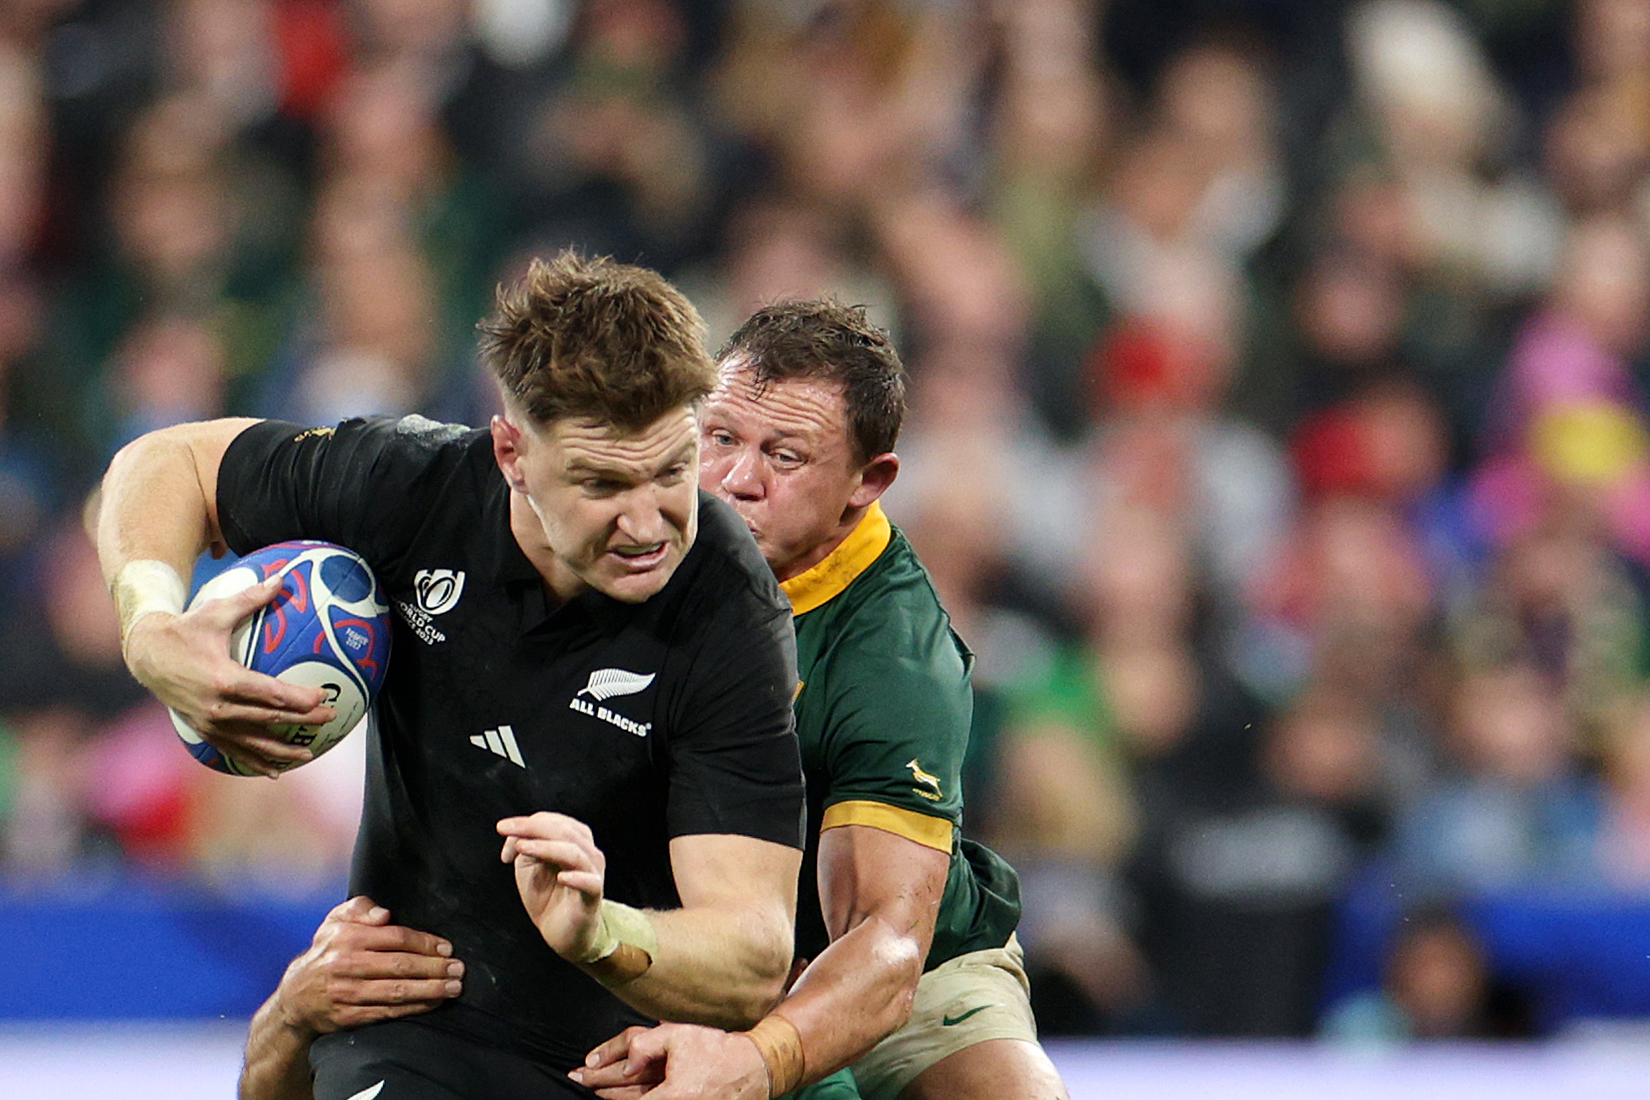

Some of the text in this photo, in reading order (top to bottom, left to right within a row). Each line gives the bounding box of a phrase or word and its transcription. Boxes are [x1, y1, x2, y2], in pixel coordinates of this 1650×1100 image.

[416, 628, 434, 646] 2023
[425, 625, 446, 643] CUP
[569, 698, 594, 717] ALL
